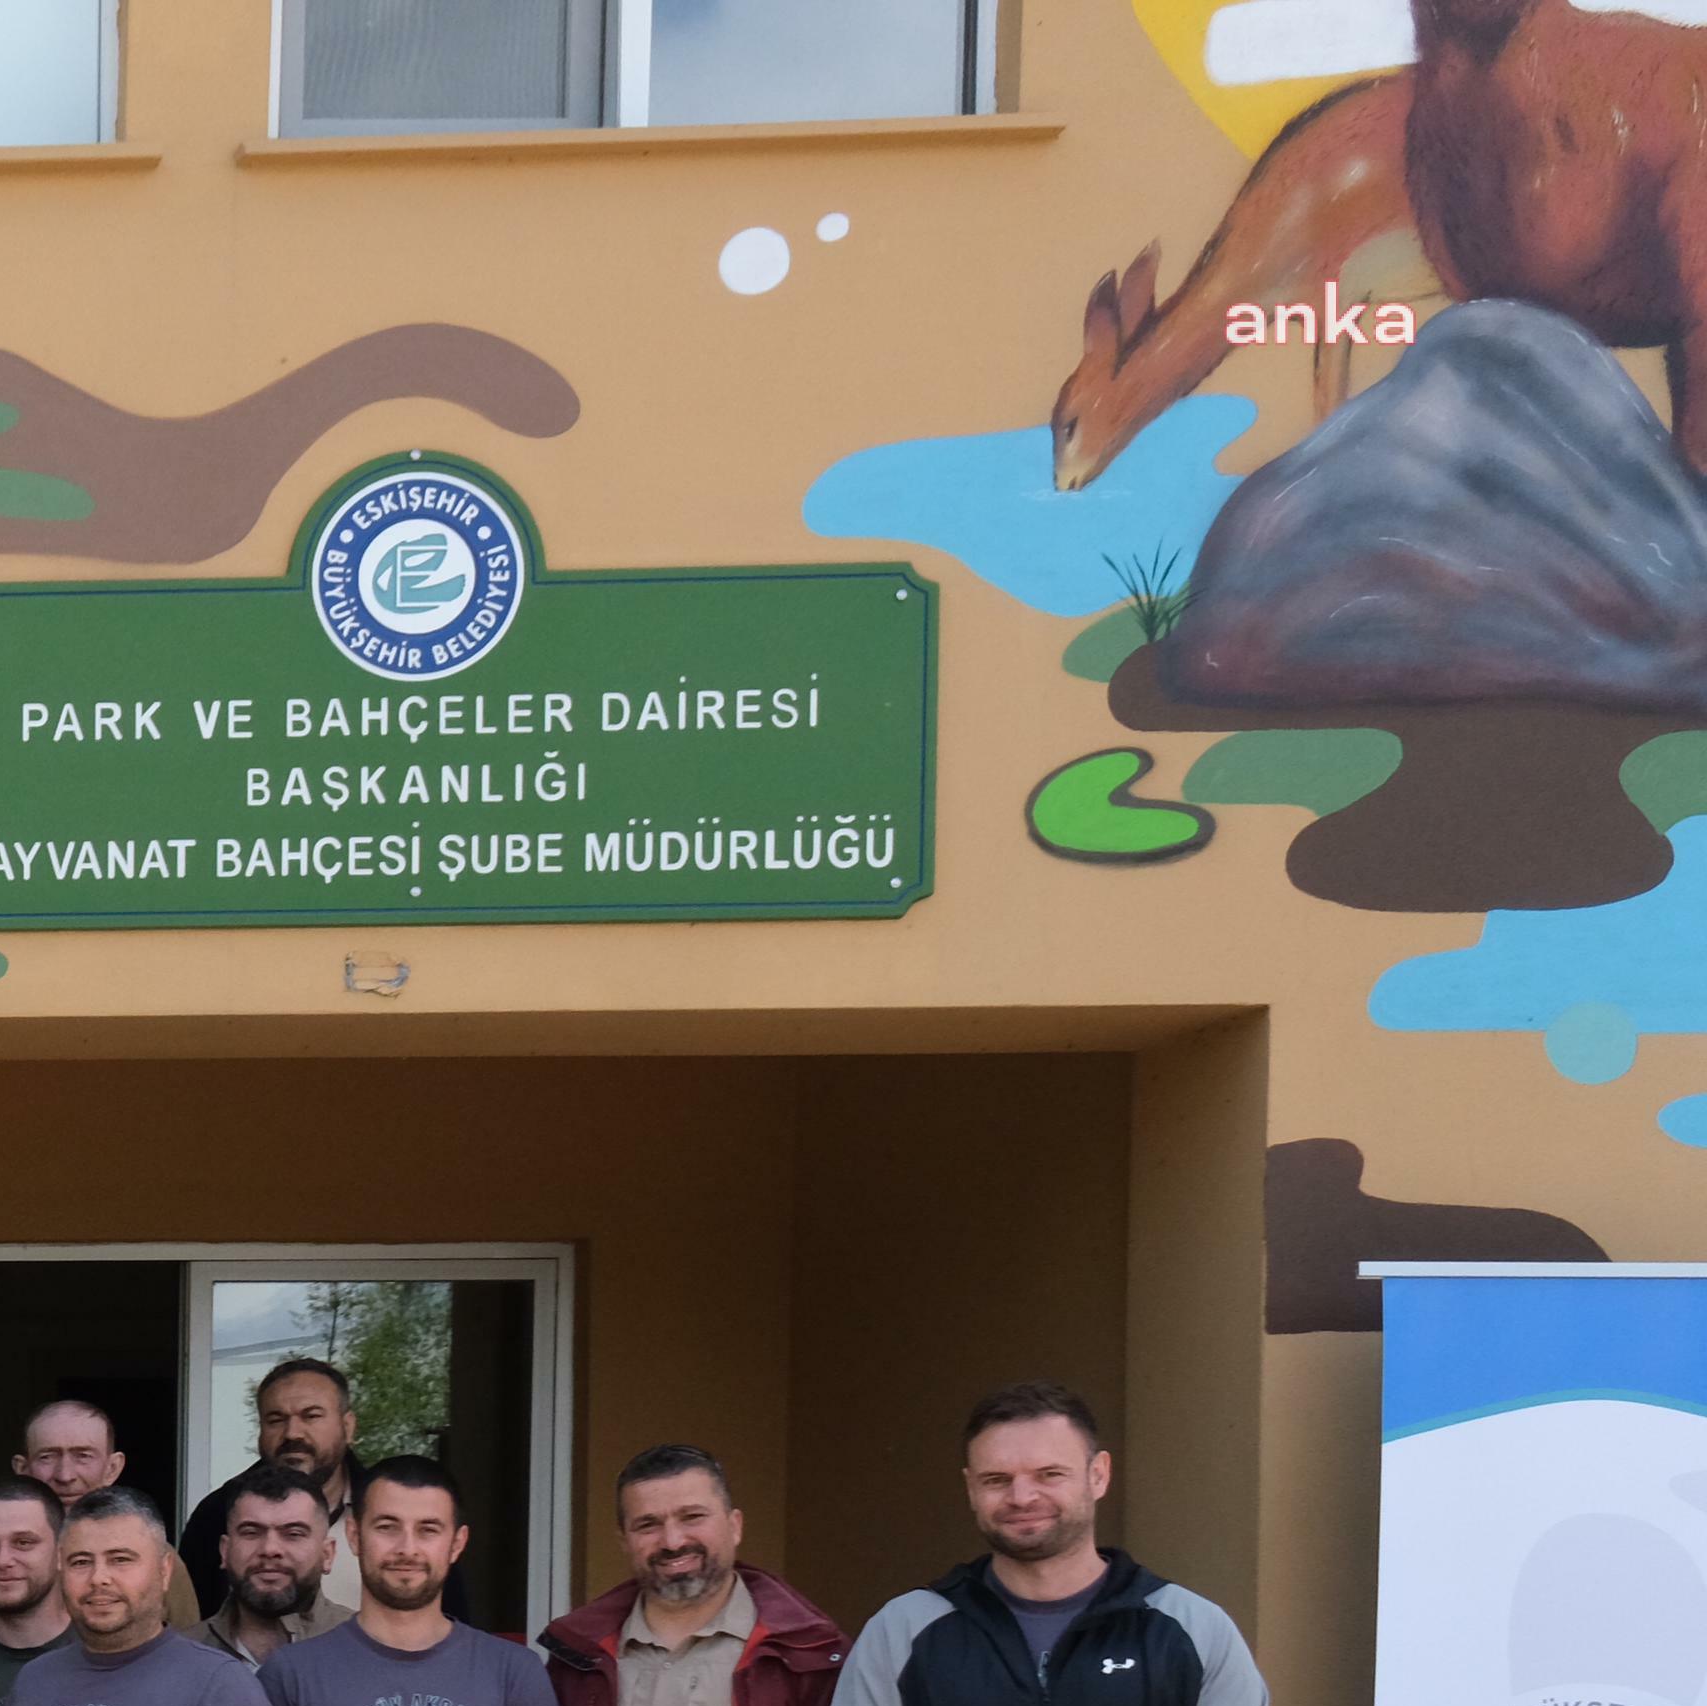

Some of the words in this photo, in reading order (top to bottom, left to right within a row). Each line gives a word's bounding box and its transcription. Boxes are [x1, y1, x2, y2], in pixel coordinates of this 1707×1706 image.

[352, 483, 480, 531] ESKİŞEHİR
[323, 549, 422, 669] BÜYÜKŞEHİR
[431, 543, 510, 665] BELEDİYESİ
[21, 700, 163, 743] PARK
[192, 699, 254, 740] VE
[285, 692, 574, 743] BAHÇELER
[600, 672, 819, 732] DAİRESİ
[245, 750, 587, 812] BAŞKANLIĞI
[215, 820, 421, 884] BAHÇESİ
[437, 832, 564, 882] ŞUBE
[584, 813, 896, 873] MÜDÜRLÜĞÜ
